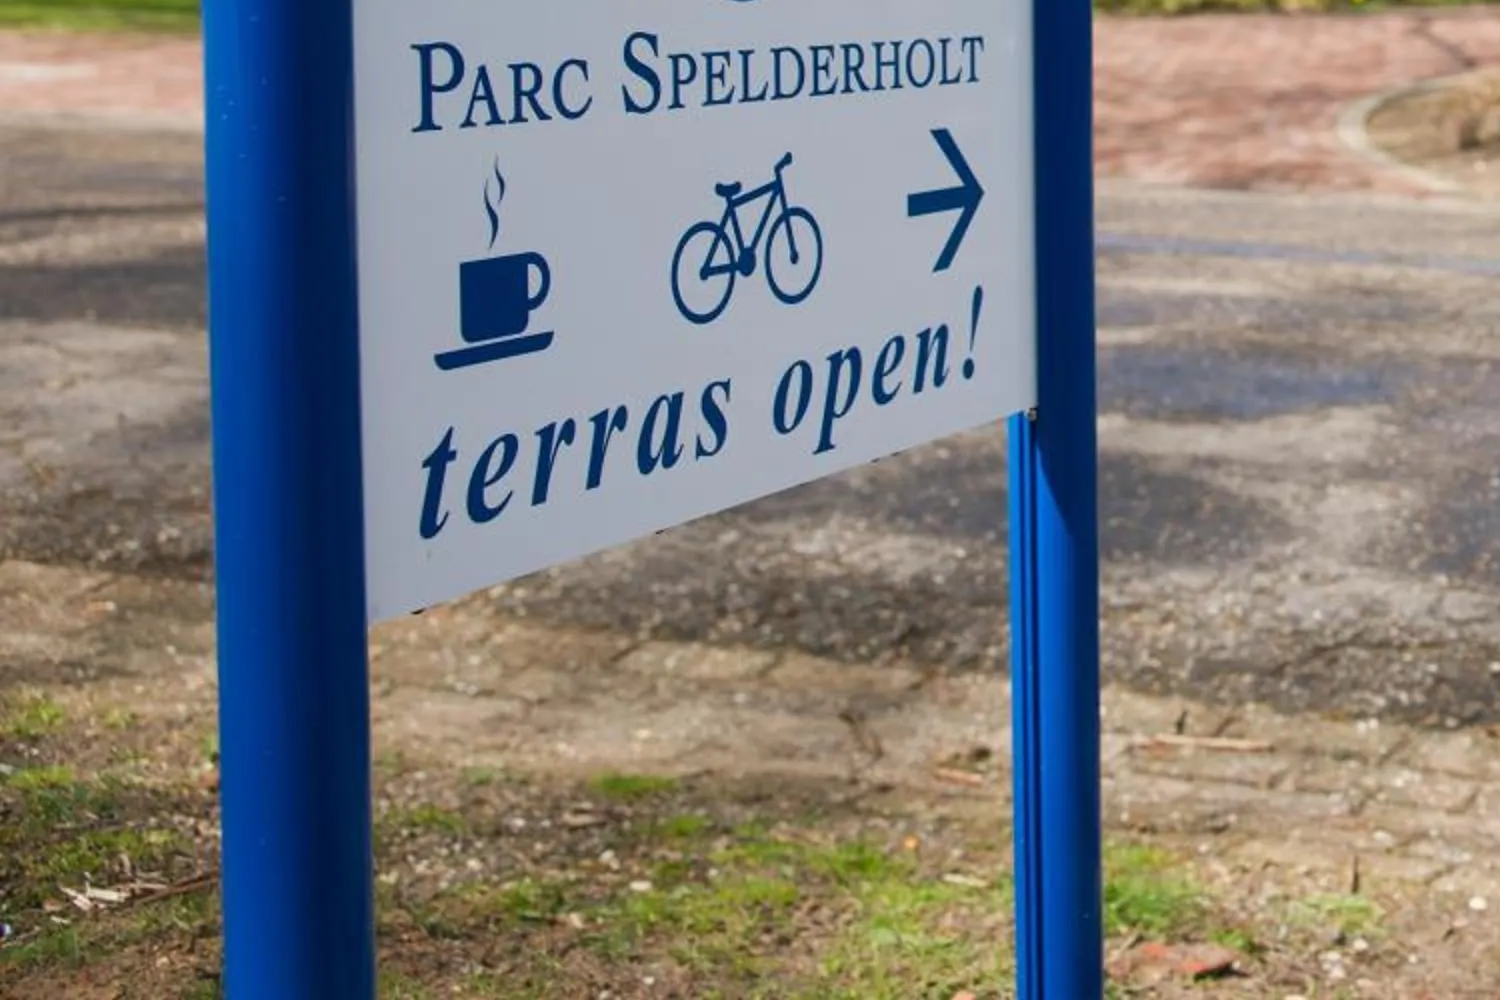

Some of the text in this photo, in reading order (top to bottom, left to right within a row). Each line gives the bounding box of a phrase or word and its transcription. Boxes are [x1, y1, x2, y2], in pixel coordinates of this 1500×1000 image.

[410, 31, 985, 133] PARC SPELDERHOLT
[418, 285, 984, 541] terras open!
